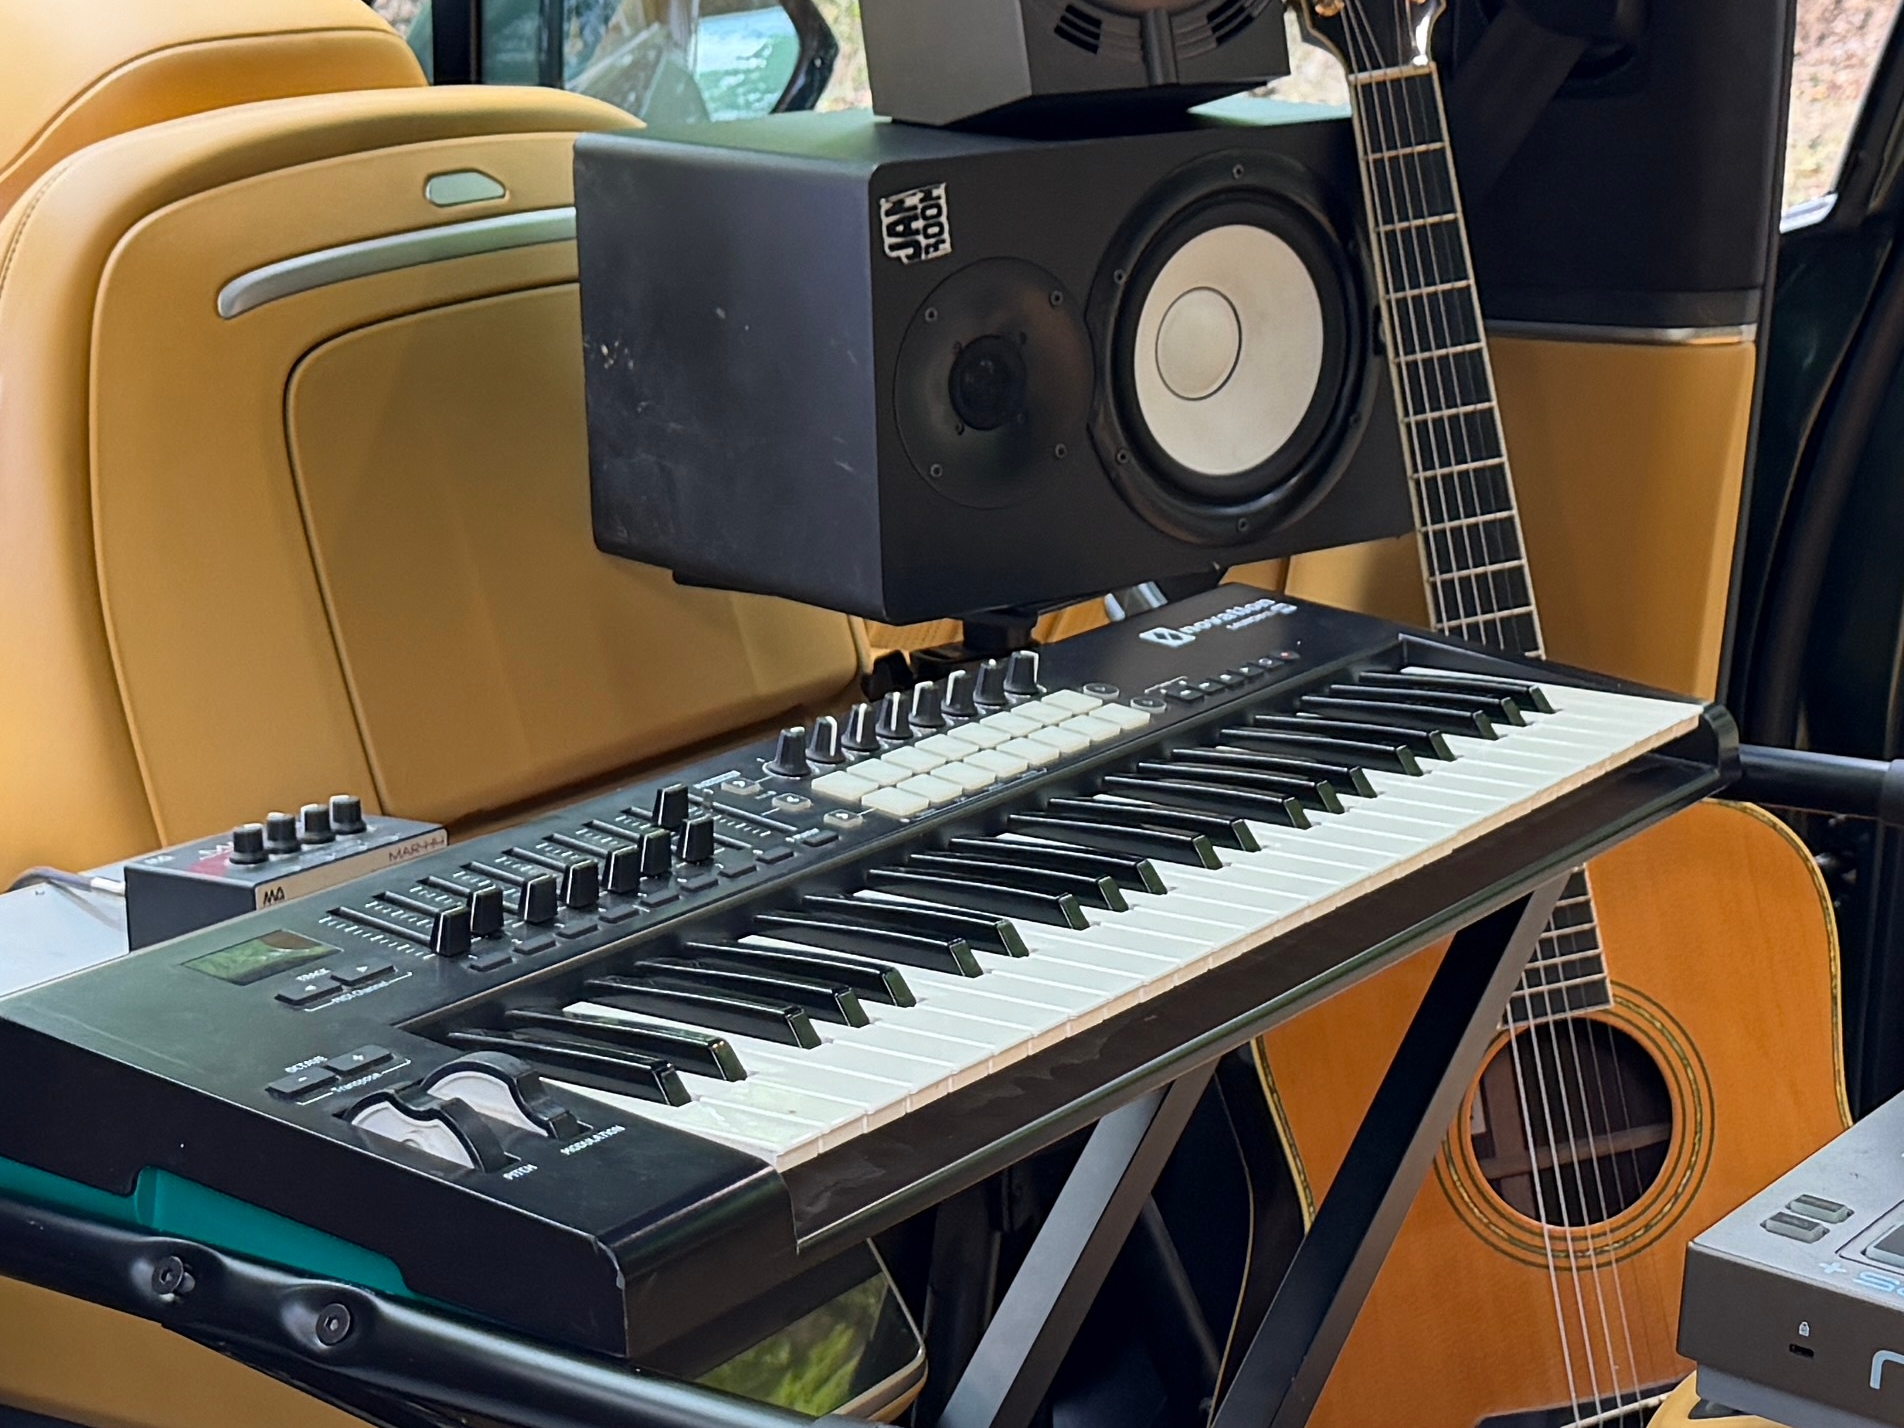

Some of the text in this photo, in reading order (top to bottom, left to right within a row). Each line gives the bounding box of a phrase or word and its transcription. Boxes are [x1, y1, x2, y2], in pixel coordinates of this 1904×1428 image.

[1178, 598, 1276, 634] novation
[560, 1124, 626, 1156] MODULATION
[503, 1163, 538, 1181] PITCH
